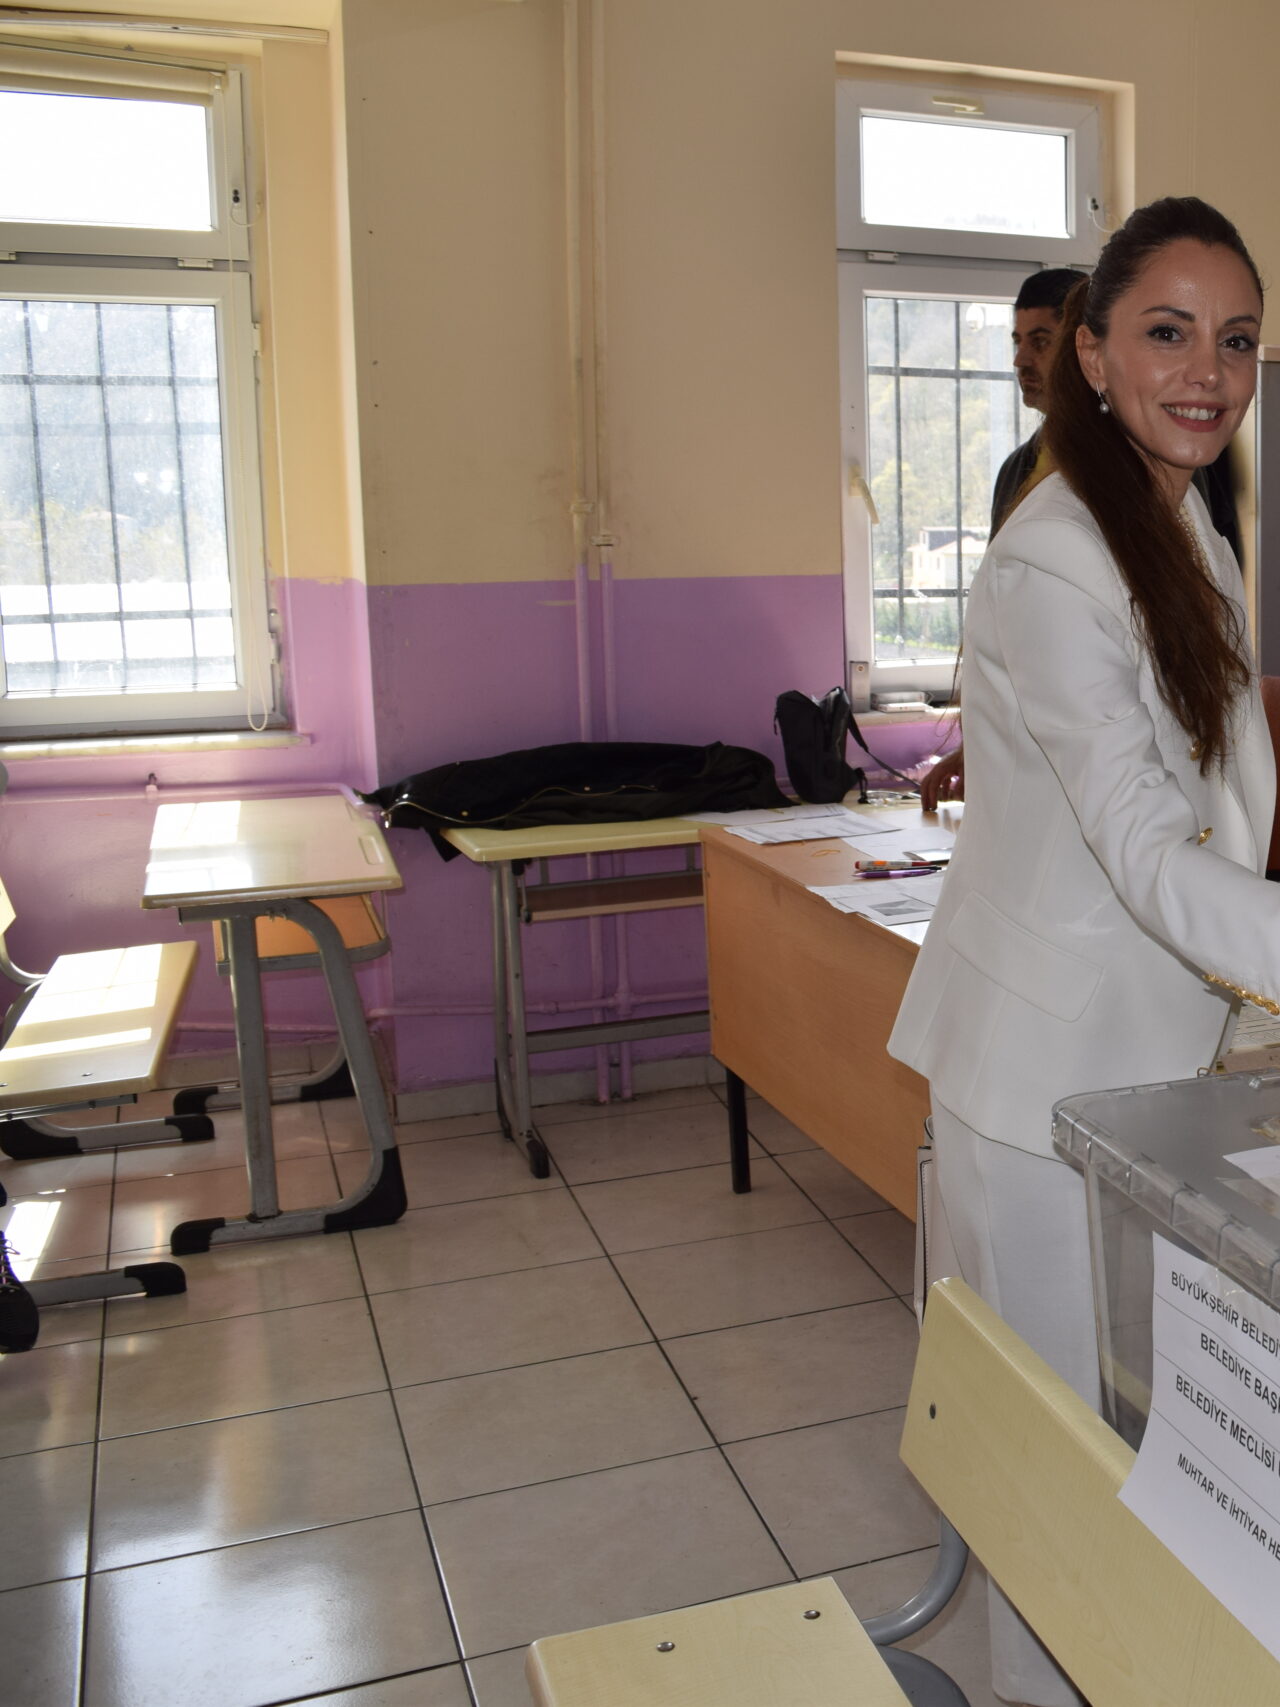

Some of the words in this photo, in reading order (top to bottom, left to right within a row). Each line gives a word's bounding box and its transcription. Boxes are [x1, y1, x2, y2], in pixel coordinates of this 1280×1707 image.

[1171, 1271, 1239, 1329] BÜYÜKŞEHİR
[1200, 1333, 1252, 1389] BELEDİYE
[1176, 1374, 1228, 1431] BELEDİYE
[1229, 1419, 1276, 1472] MECLİSİ
[1177, 1453, 1215, 1497] MUHTAR
[1216, 1487, 1228, 1510] VE
[1229, 1498, 1267, 1547] İHTİYAR
